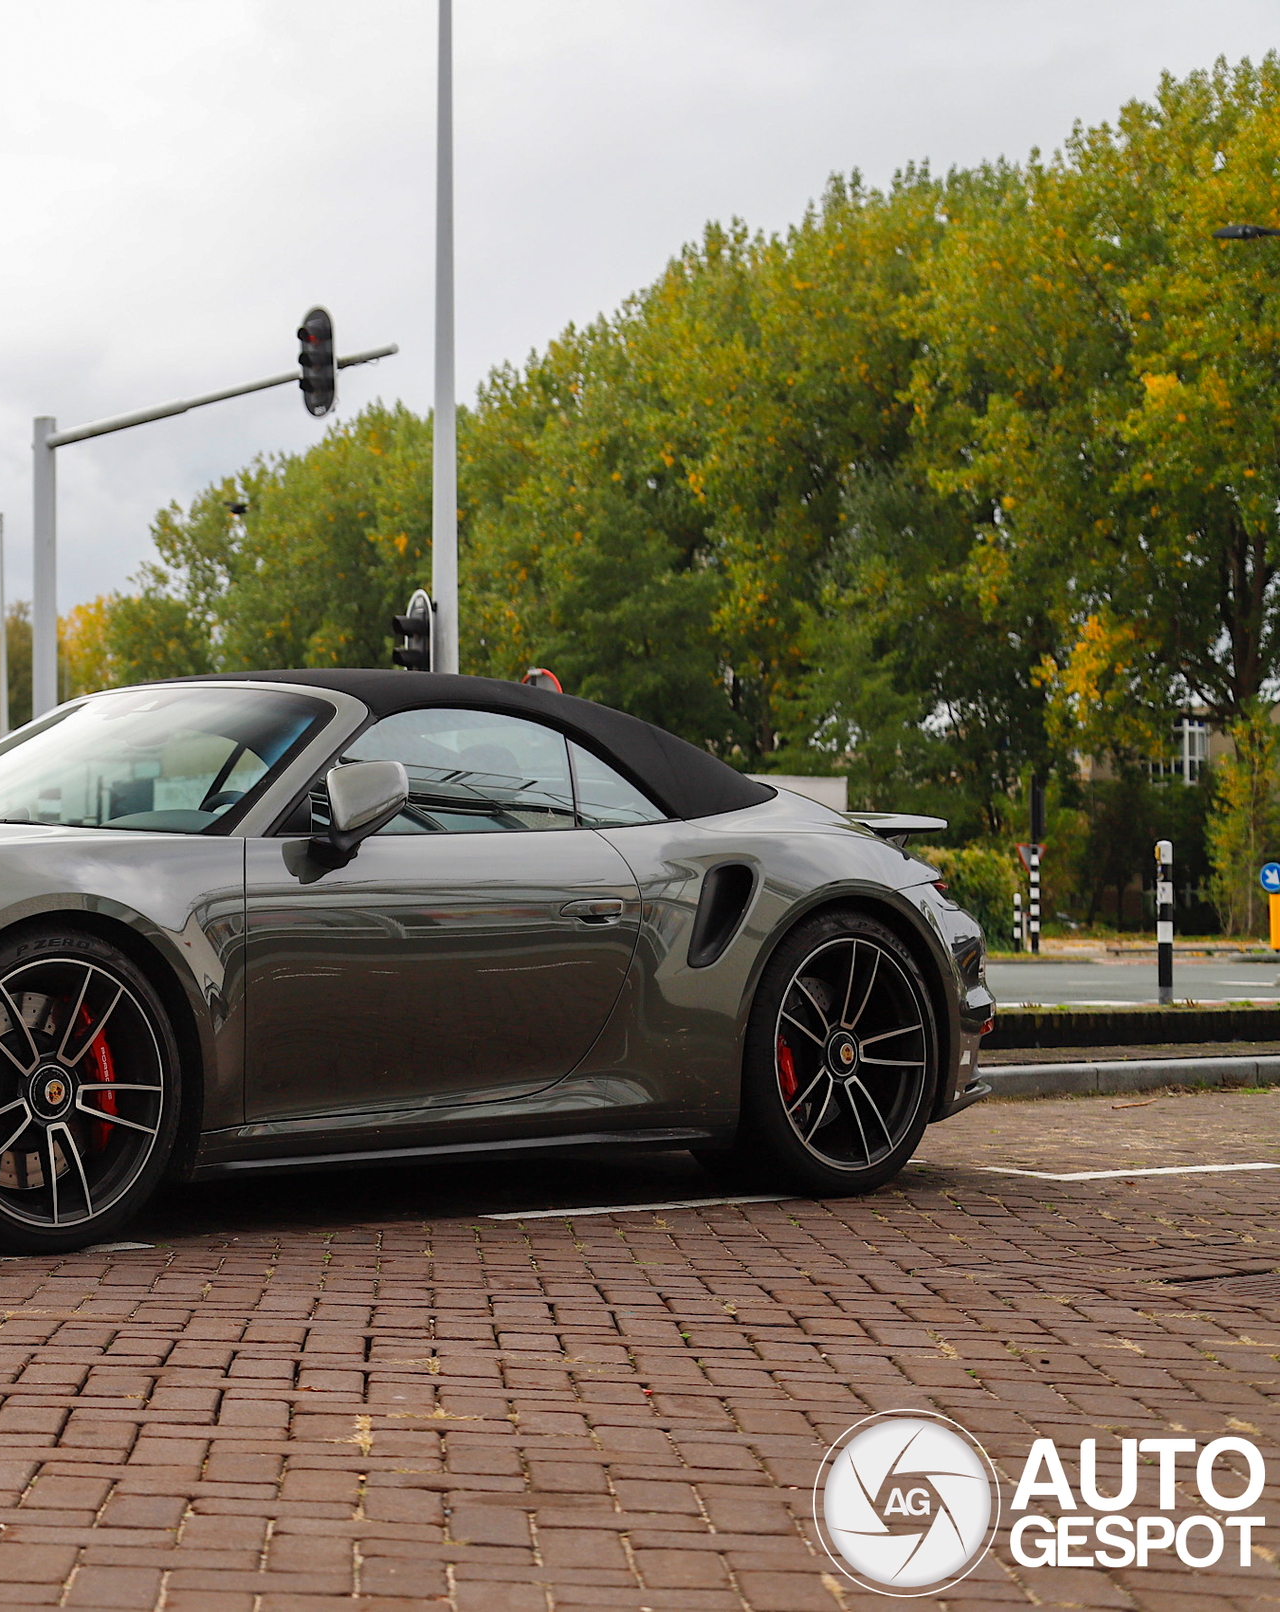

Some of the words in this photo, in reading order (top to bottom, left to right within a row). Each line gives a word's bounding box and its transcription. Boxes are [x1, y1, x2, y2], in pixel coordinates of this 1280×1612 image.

[16, 945, 28, 956] P
[33, 938, 90, 950] ZERO
[100, 1046, 113, 1100] PORSCE
